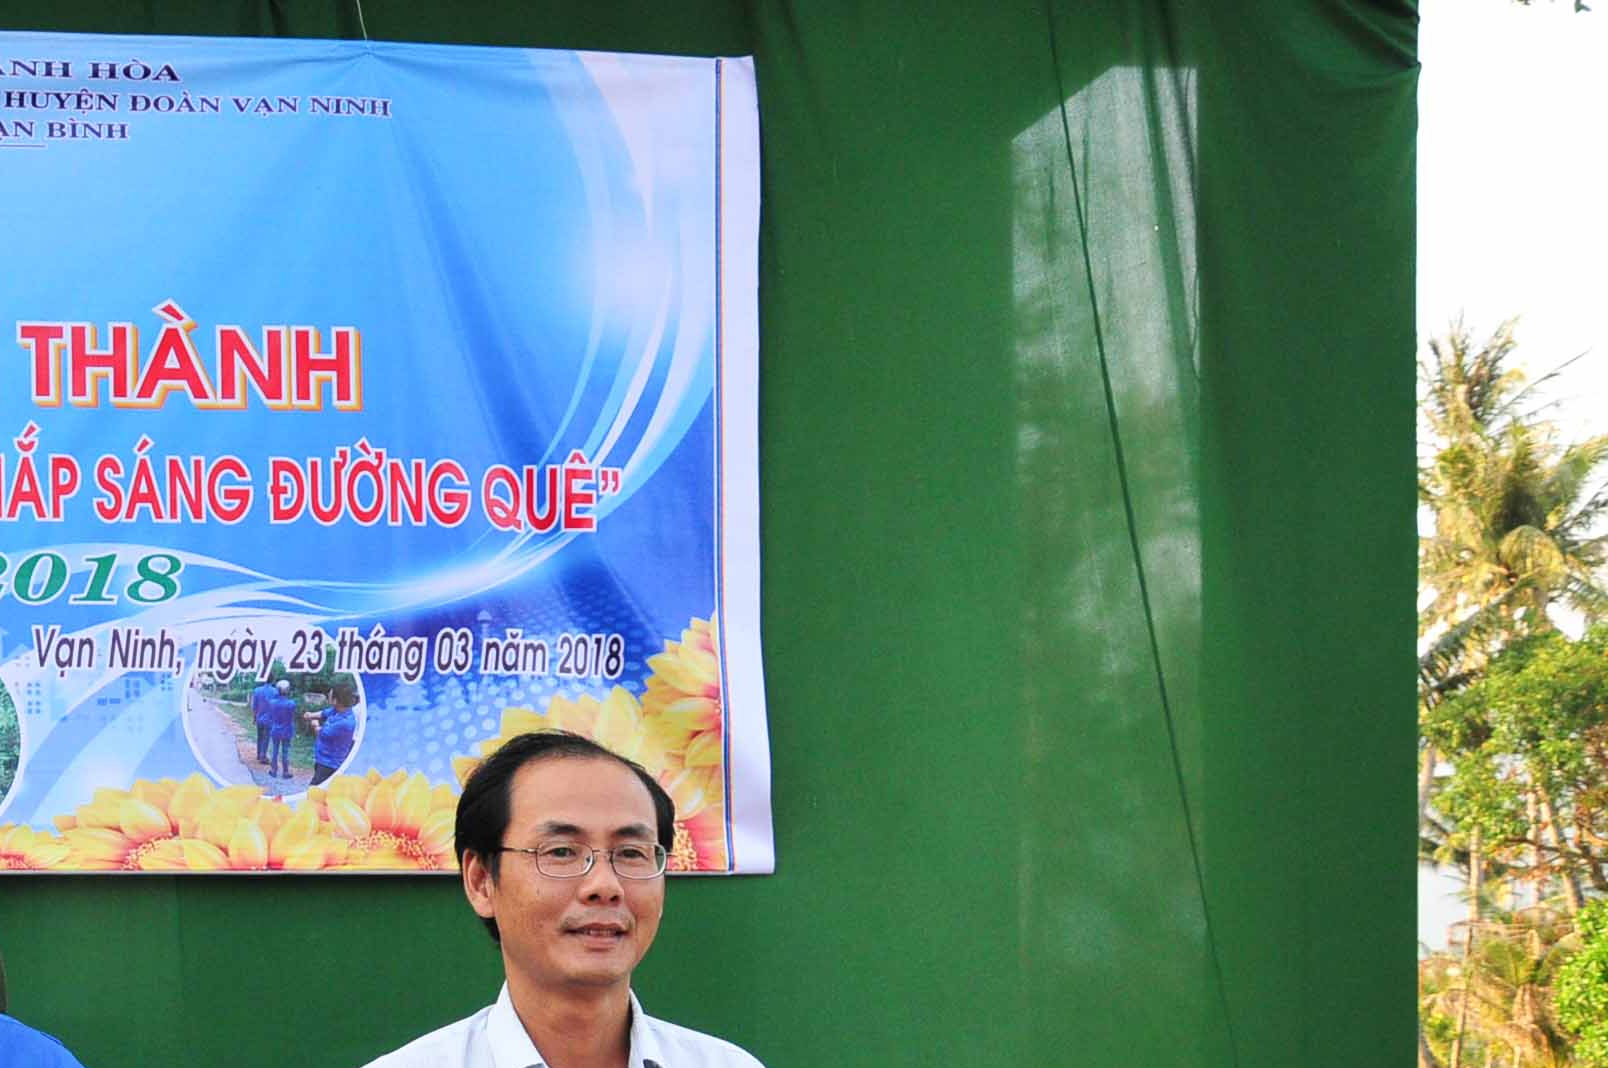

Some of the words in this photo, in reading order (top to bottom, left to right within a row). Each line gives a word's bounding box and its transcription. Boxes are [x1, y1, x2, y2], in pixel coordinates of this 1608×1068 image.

[88, 57, 180, 82] HÒA
[4, 88, 118, 114] HUYỆN
[130, 91, 220, 113] ĐOÀN
[231, 96, 299, 116] VẠN
[309, 96, 392, 117] NINH
[47, 118, 129, 140] BÌNH
[17, 298, 362, 411] THÀNH
[94, 435, 251, 523] SÁNG
[269, 438, 470, 529] ĐƯỜNG
[483, 450, 620, 533] QUÊ”
[32, 624, 95, 673] Vạn
[109, 625, 183, 677] Ninh,
[197, 626, 276, 682] ngày
[289, 627, 325, 674] 23
[335, 624, 422, 684] tháng
[434, 631, 470, 675] 03
[481, 628, 549, 679] năm
[559, 632, 623, 681] 2018
